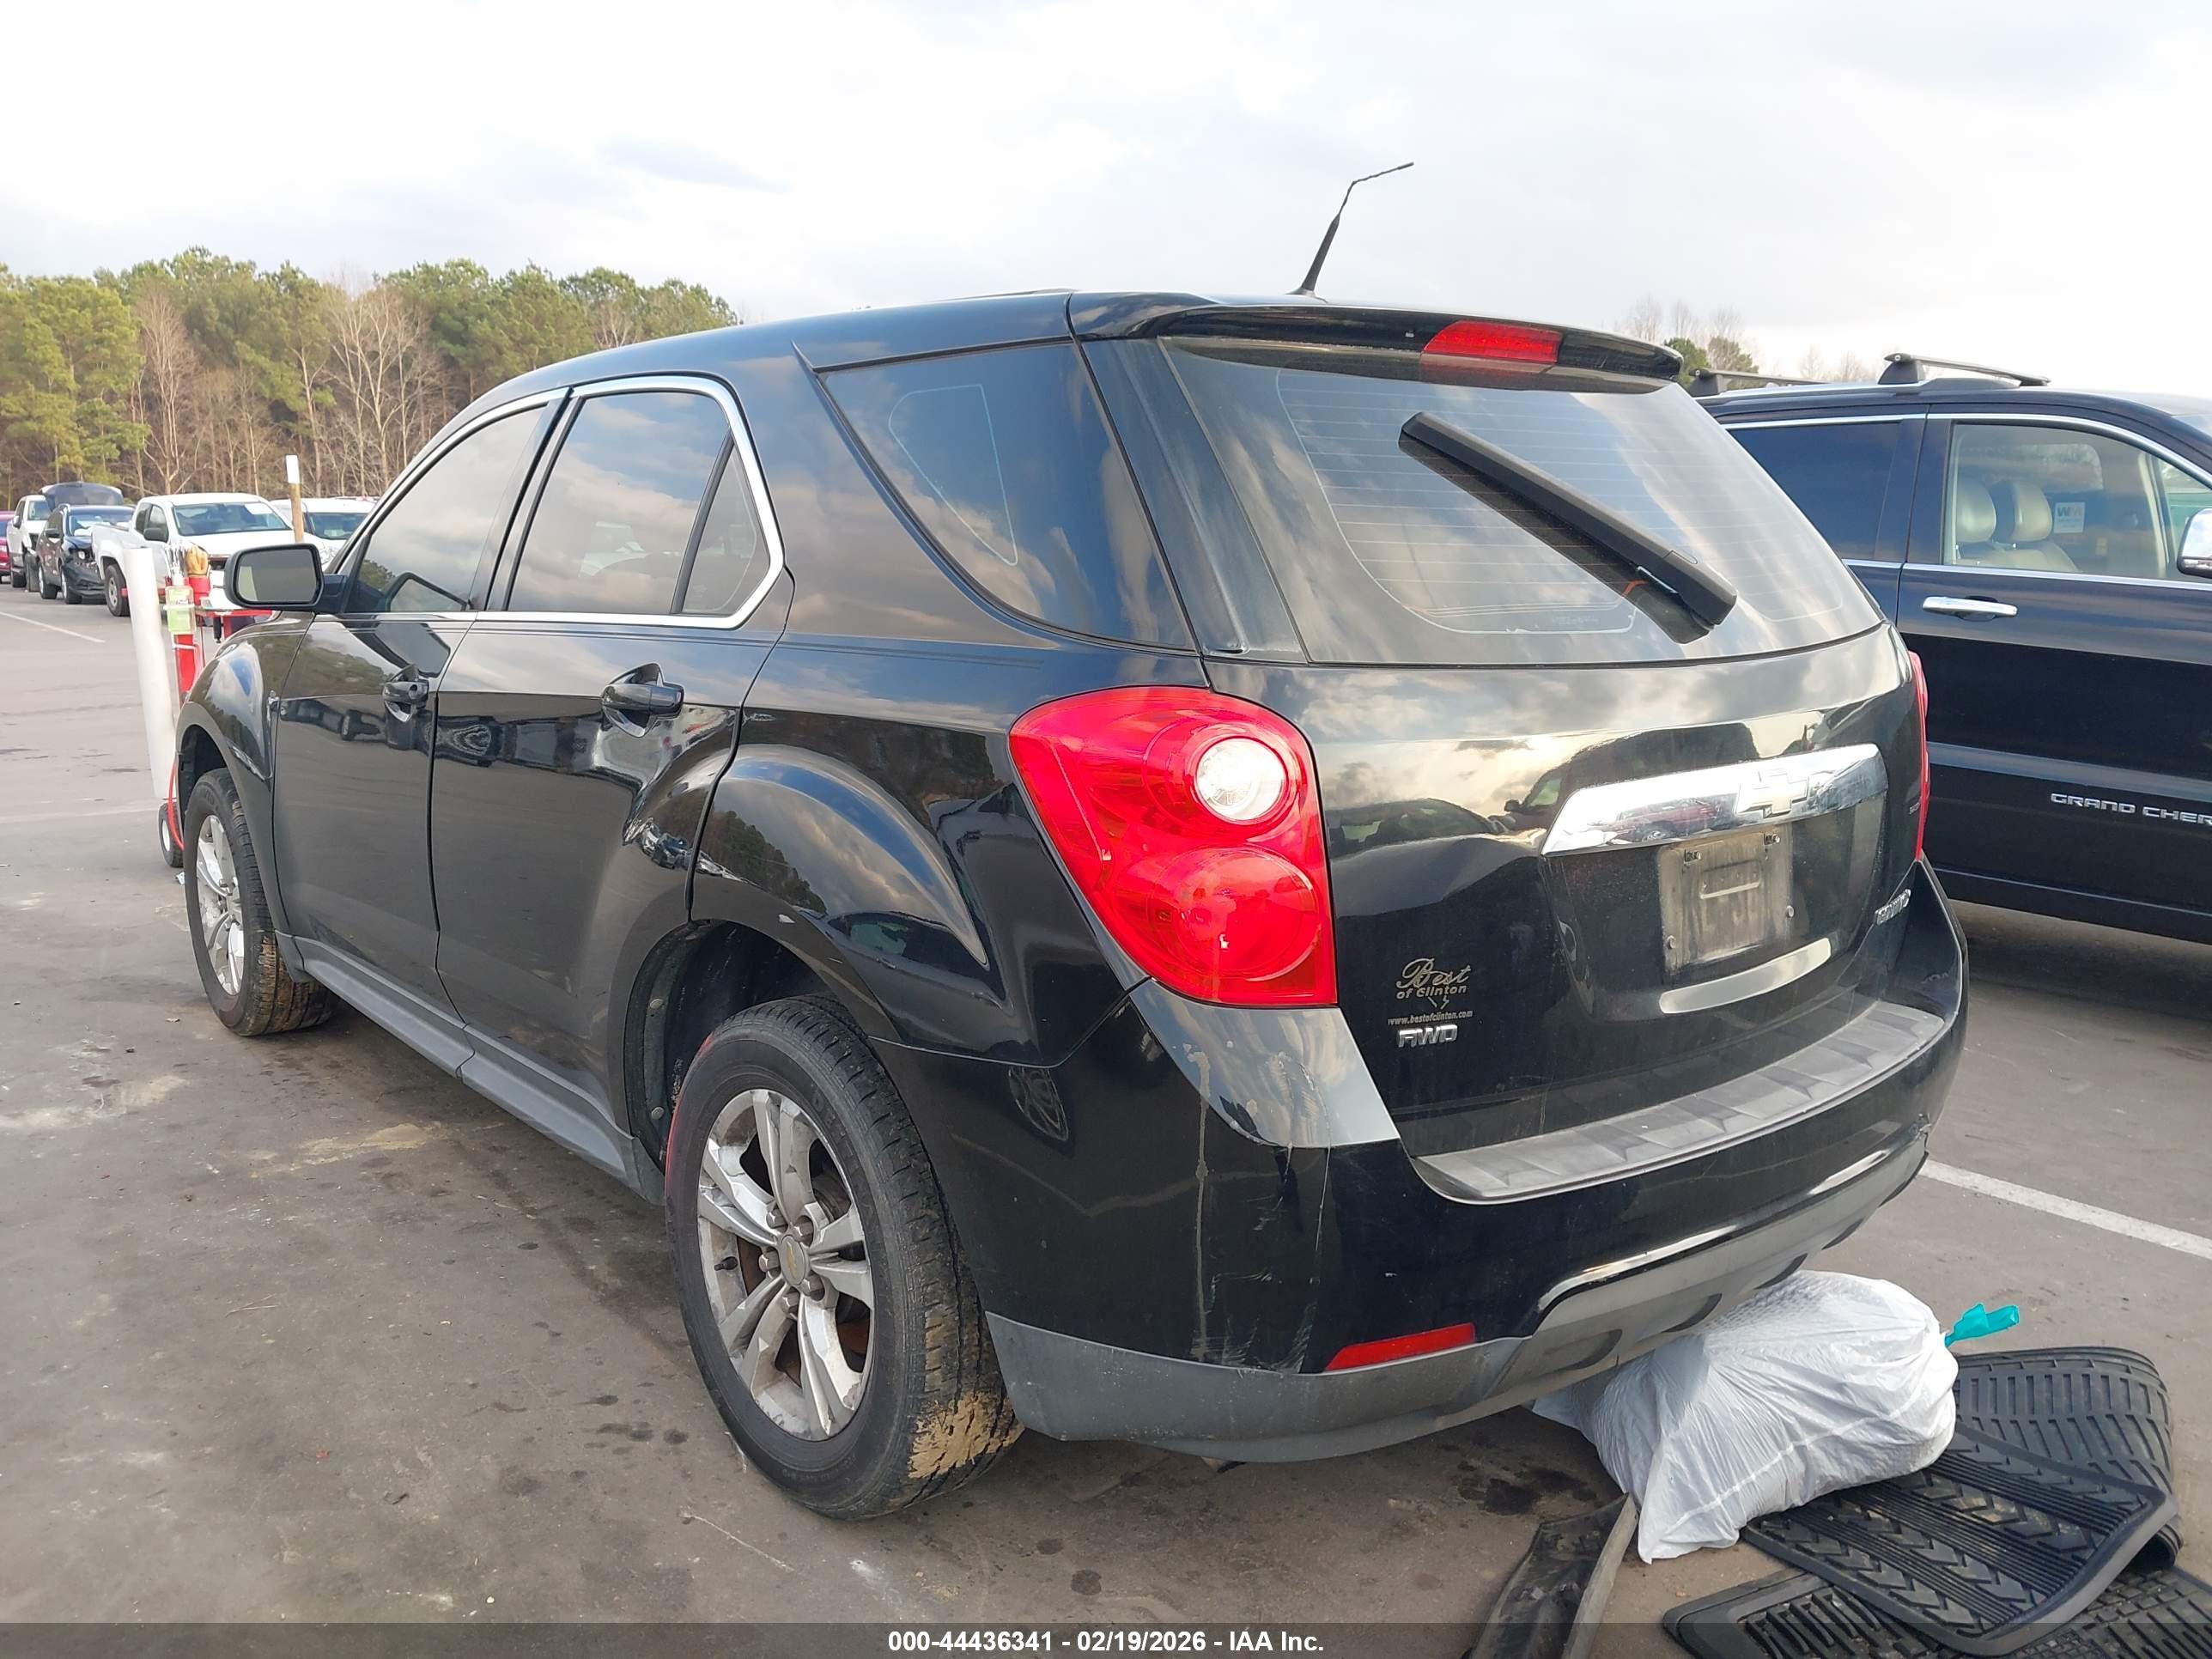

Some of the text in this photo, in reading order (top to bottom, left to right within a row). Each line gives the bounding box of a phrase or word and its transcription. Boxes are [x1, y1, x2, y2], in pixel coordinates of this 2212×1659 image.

[2051, 793, 2136, 814] GRAND
[1396, 957, 1471, 988] Best
[1396, 985, 1467, 1000] of Clinton
[1388, 1011, 1474, 1025] www.bestofclinton.com
[1397, 1024, 1458, 1048] AWD
